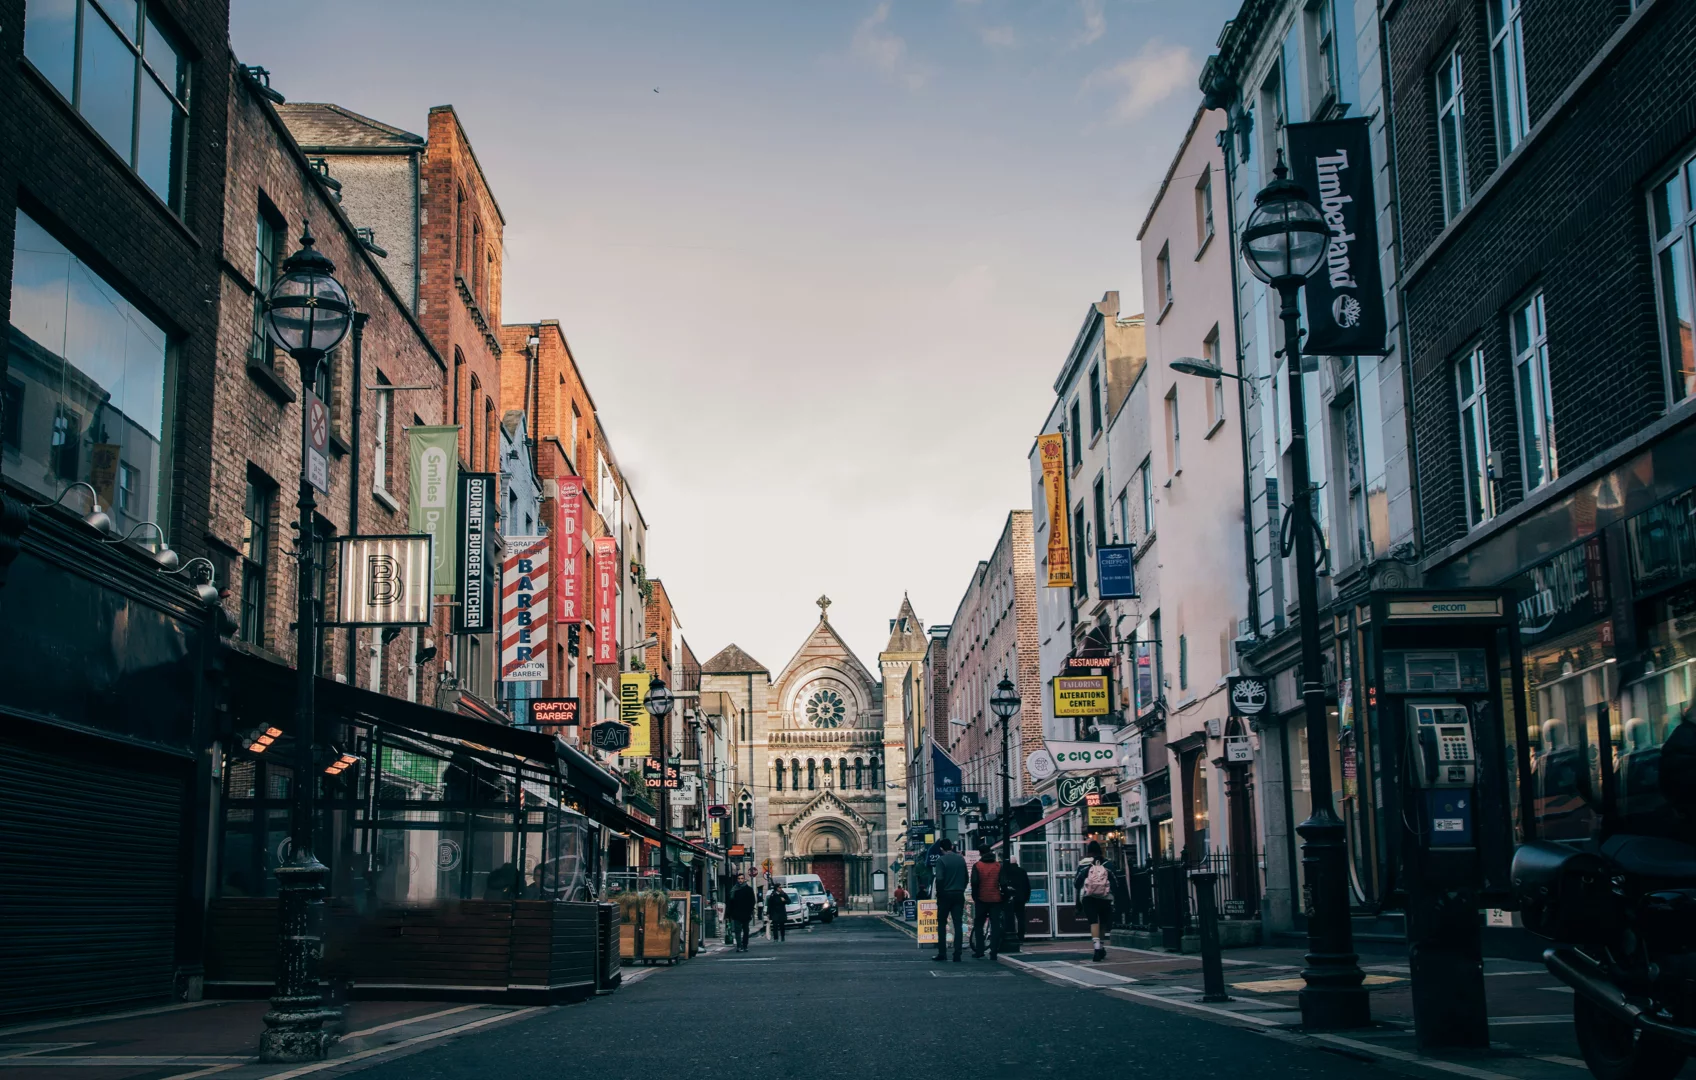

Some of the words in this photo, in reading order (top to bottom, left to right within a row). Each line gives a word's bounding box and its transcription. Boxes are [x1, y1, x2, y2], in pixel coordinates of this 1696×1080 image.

[1316, 149, 1358, 289] Timberland
[427, 454, 441, 502] Smiles
[469, 478, 482, 530] GOURMET
[468, 532, 482, 573] BURGER
[564, 517, 575, 618] DINER
[368, 555, 404, 607] B
[467, 574, 481, 628] KITCHEN
[517, 558, 534, 661] BARBER
[599, 573, 610, 659] DINER
[1069, 658, 1111, 667] RESTAURANT
[533, 702, 577, 711] GRAFTON
[535, 711, 574, 721] BARBER
[1059, 691, 1106, 699] ALTERATIONS
[593, 728, 628, 746] EAT
[1057, 753, 1066, 762] e
[1068, 751, 1091, 763] cig
[1094, 749, 1113, 759] co
[943, 801, 958, 812] 22
